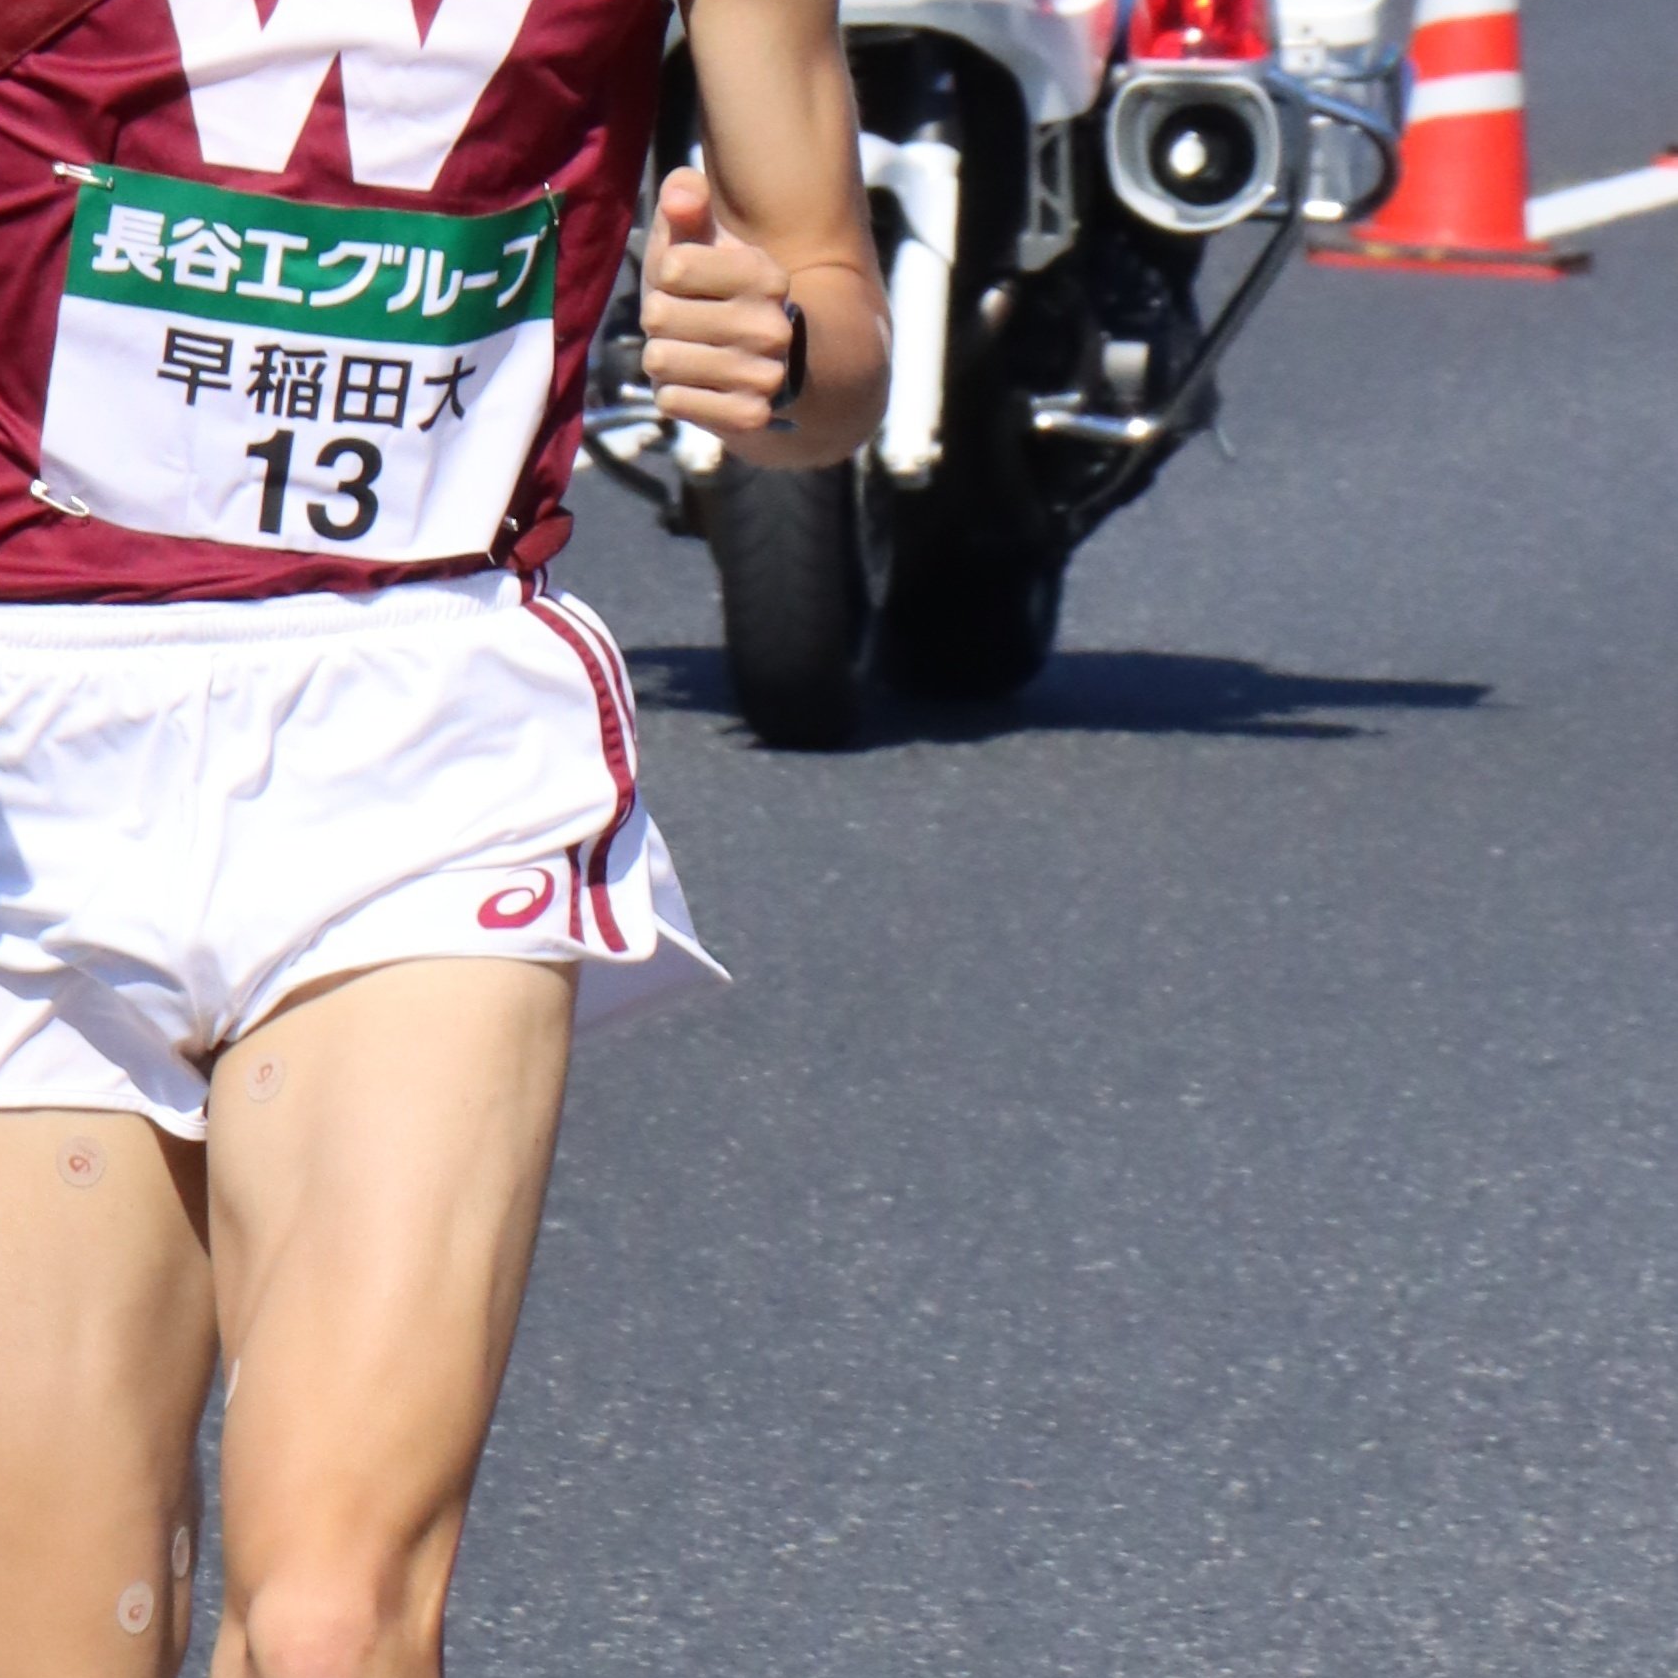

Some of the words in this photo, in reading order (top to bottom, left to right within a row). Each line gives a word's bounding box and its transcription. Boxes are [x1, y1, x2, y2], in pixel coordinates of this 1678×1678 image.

[90, 204, 548, 316] 長谷工グループ
[156, 326, 478, 432] 早稲田大
[245, 428, 384, 542] 13
